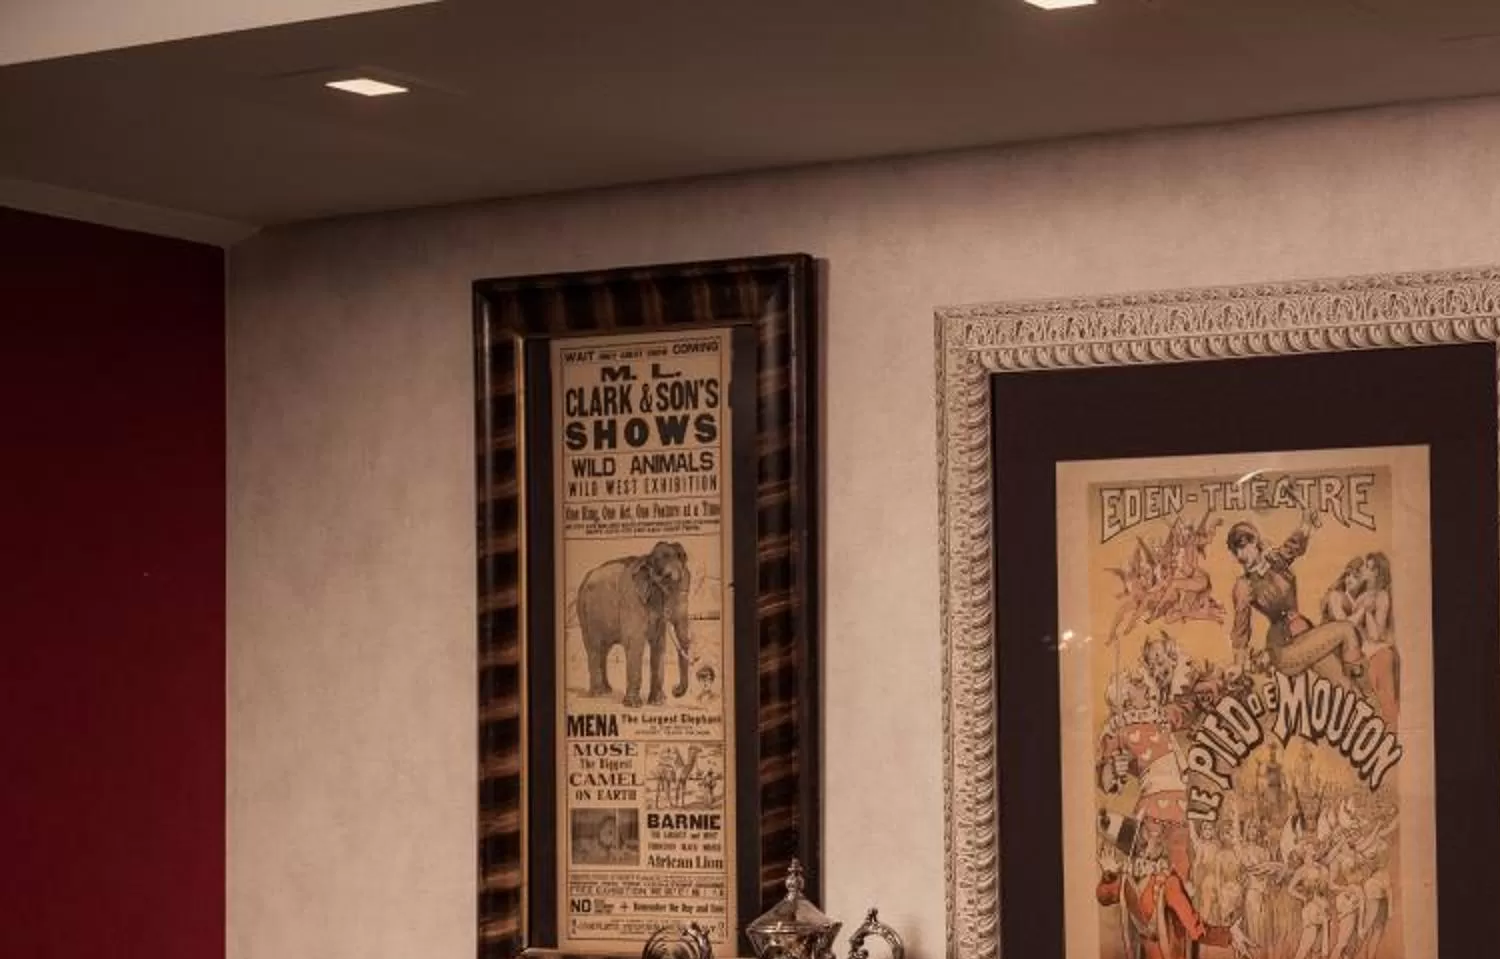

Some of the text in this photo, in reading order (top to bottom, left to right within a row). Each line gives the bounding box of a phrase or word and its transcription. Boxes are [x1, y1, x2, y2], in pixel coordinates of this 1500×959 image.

[564, 351, 594, 362] WAIT
[601, 364, 682, 382] M. L.
[566, 378, 719, 417] CLARK & SON'S
[565, 414, 718, 450] SHOWS
[572, 451, 714, 478] WILD ANIMALS
[568, 475, 717, 497] WILD WEST EXHIBITION
[567, 714, 619, 737] MENA
[621, 713, 722, 726] The Largest Elephant
[572, 742, 639, 757] MOSE
[1186, 667, 1402, 821] LE PIED DE MOUTON
[569, 773, 644, 787] CAMEL
[647, 814, 721, 830] BARNIE
[570, 900, 591, 913] NO
